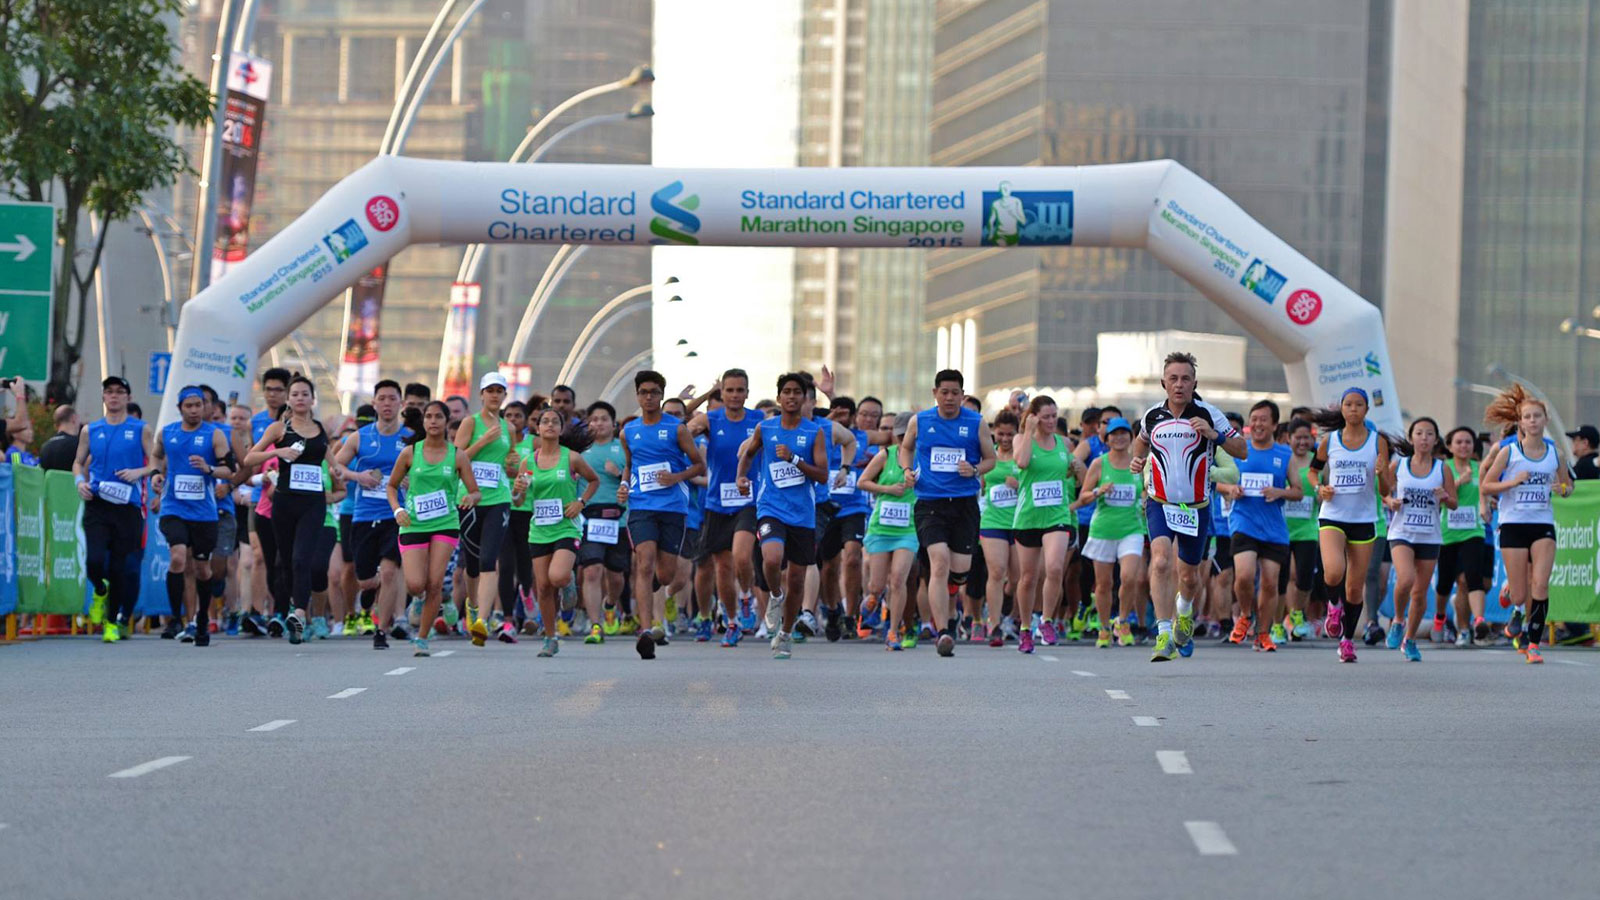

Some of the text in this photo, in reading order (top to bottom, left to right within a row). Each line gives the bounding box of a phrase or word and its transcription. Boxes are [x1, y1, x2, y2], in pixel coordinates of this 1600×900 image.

[500, 188, 636, 216] Standard
[741, 190, 965, 209] Standard Chartered
[487, 221, 636, 242] Chartered
[741, 215, 964, 237] Marathon Singapore
[1166, 200, 1249, 260] Standard Chartered
[908, 237, 963, 247] 2015
[1160, 209, 1241, 269] Marathon Singapore
[239, 244, 321, 304] Standard Chartered
[311, 264, 333, 283] 2015
[1213, 258, 1236, 279] 2015
[246, 283, 288, 313] Marathon
[286, 254, 328, 287] Singapore
[1319, 357, 1362, 373] Standard
[1319, 368, 1364, 385] Chartered
[934, 453, 962, 464] 65497
[293, 471, 320, 481] 61358
[474, 468, 499, 478] 67961
[1336, 474, 1363, 484] 77865
[1035, 487, 1061, 497] 72705
[1519, 491, 1546, 500] 77765
[417, 497, 445, 511] 73760
[535, 505, 560, 515] 73759
[882, 507, 908, 517] 74311
[1406, 514, 1432, 524] 77871
[1554, 520, 1594, 549] tandard
